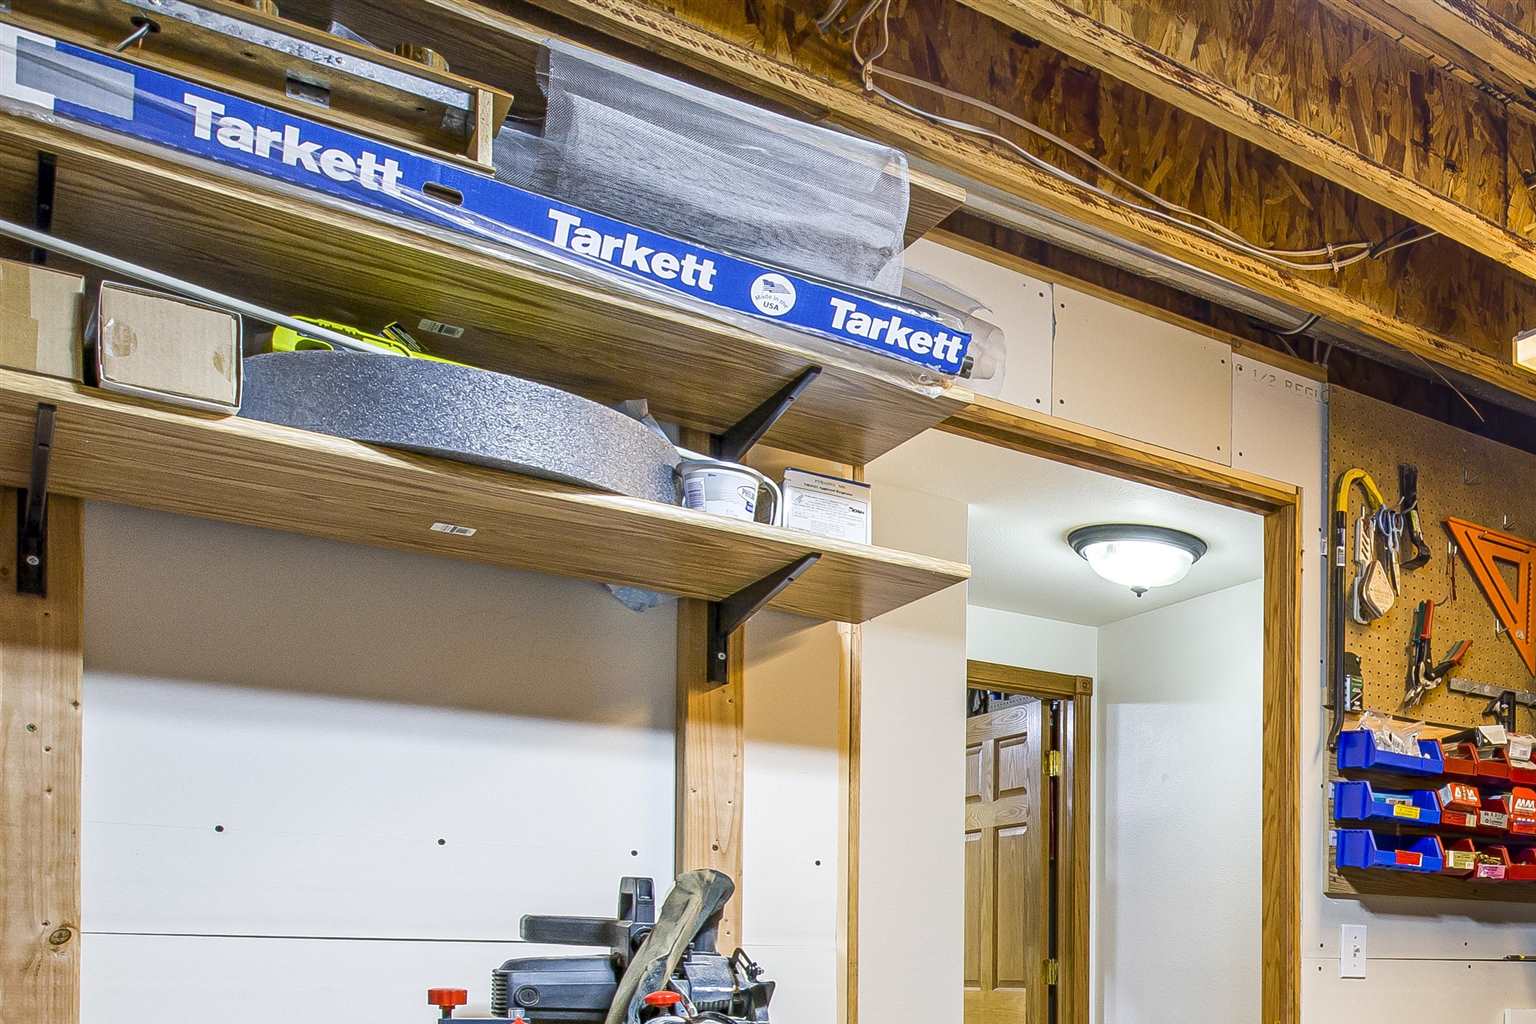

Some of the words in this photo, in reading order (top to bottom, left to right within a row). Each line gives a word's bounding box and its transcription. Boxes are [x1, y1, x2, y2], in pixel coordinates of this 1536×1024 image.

[183, 92, 404, 196] Tarkett
[547, 207, 718, 293] Tarkett
[762, 300, 780, 312] USA
[830, 297, 963, 364] Tarkett
